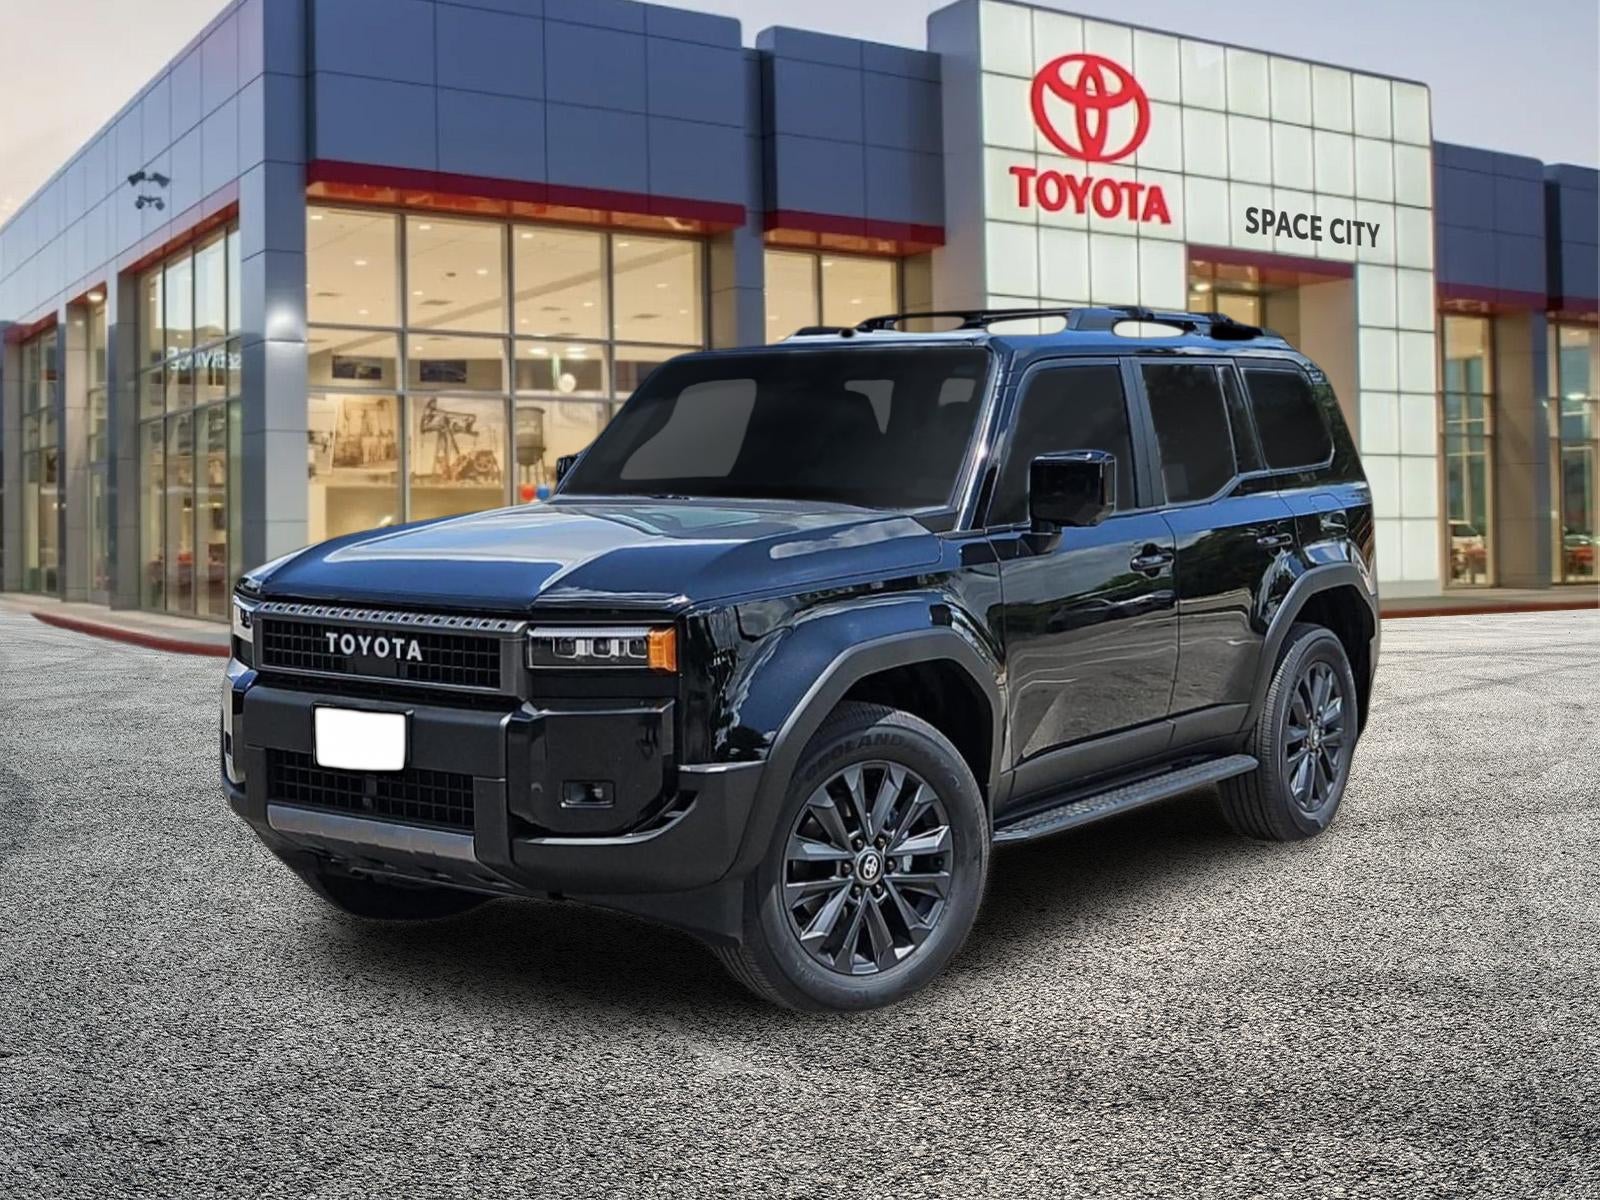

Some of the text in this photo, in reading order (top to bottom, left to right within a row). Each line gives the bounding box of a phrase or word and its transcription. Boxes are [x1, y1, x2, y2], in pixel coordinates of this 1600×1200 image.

[1009, 166, 1171, 224] TOYOTA
[1245, 206, 1381, 248] SPACE CITY
[325, 632, 423, 661] TOYOTA
